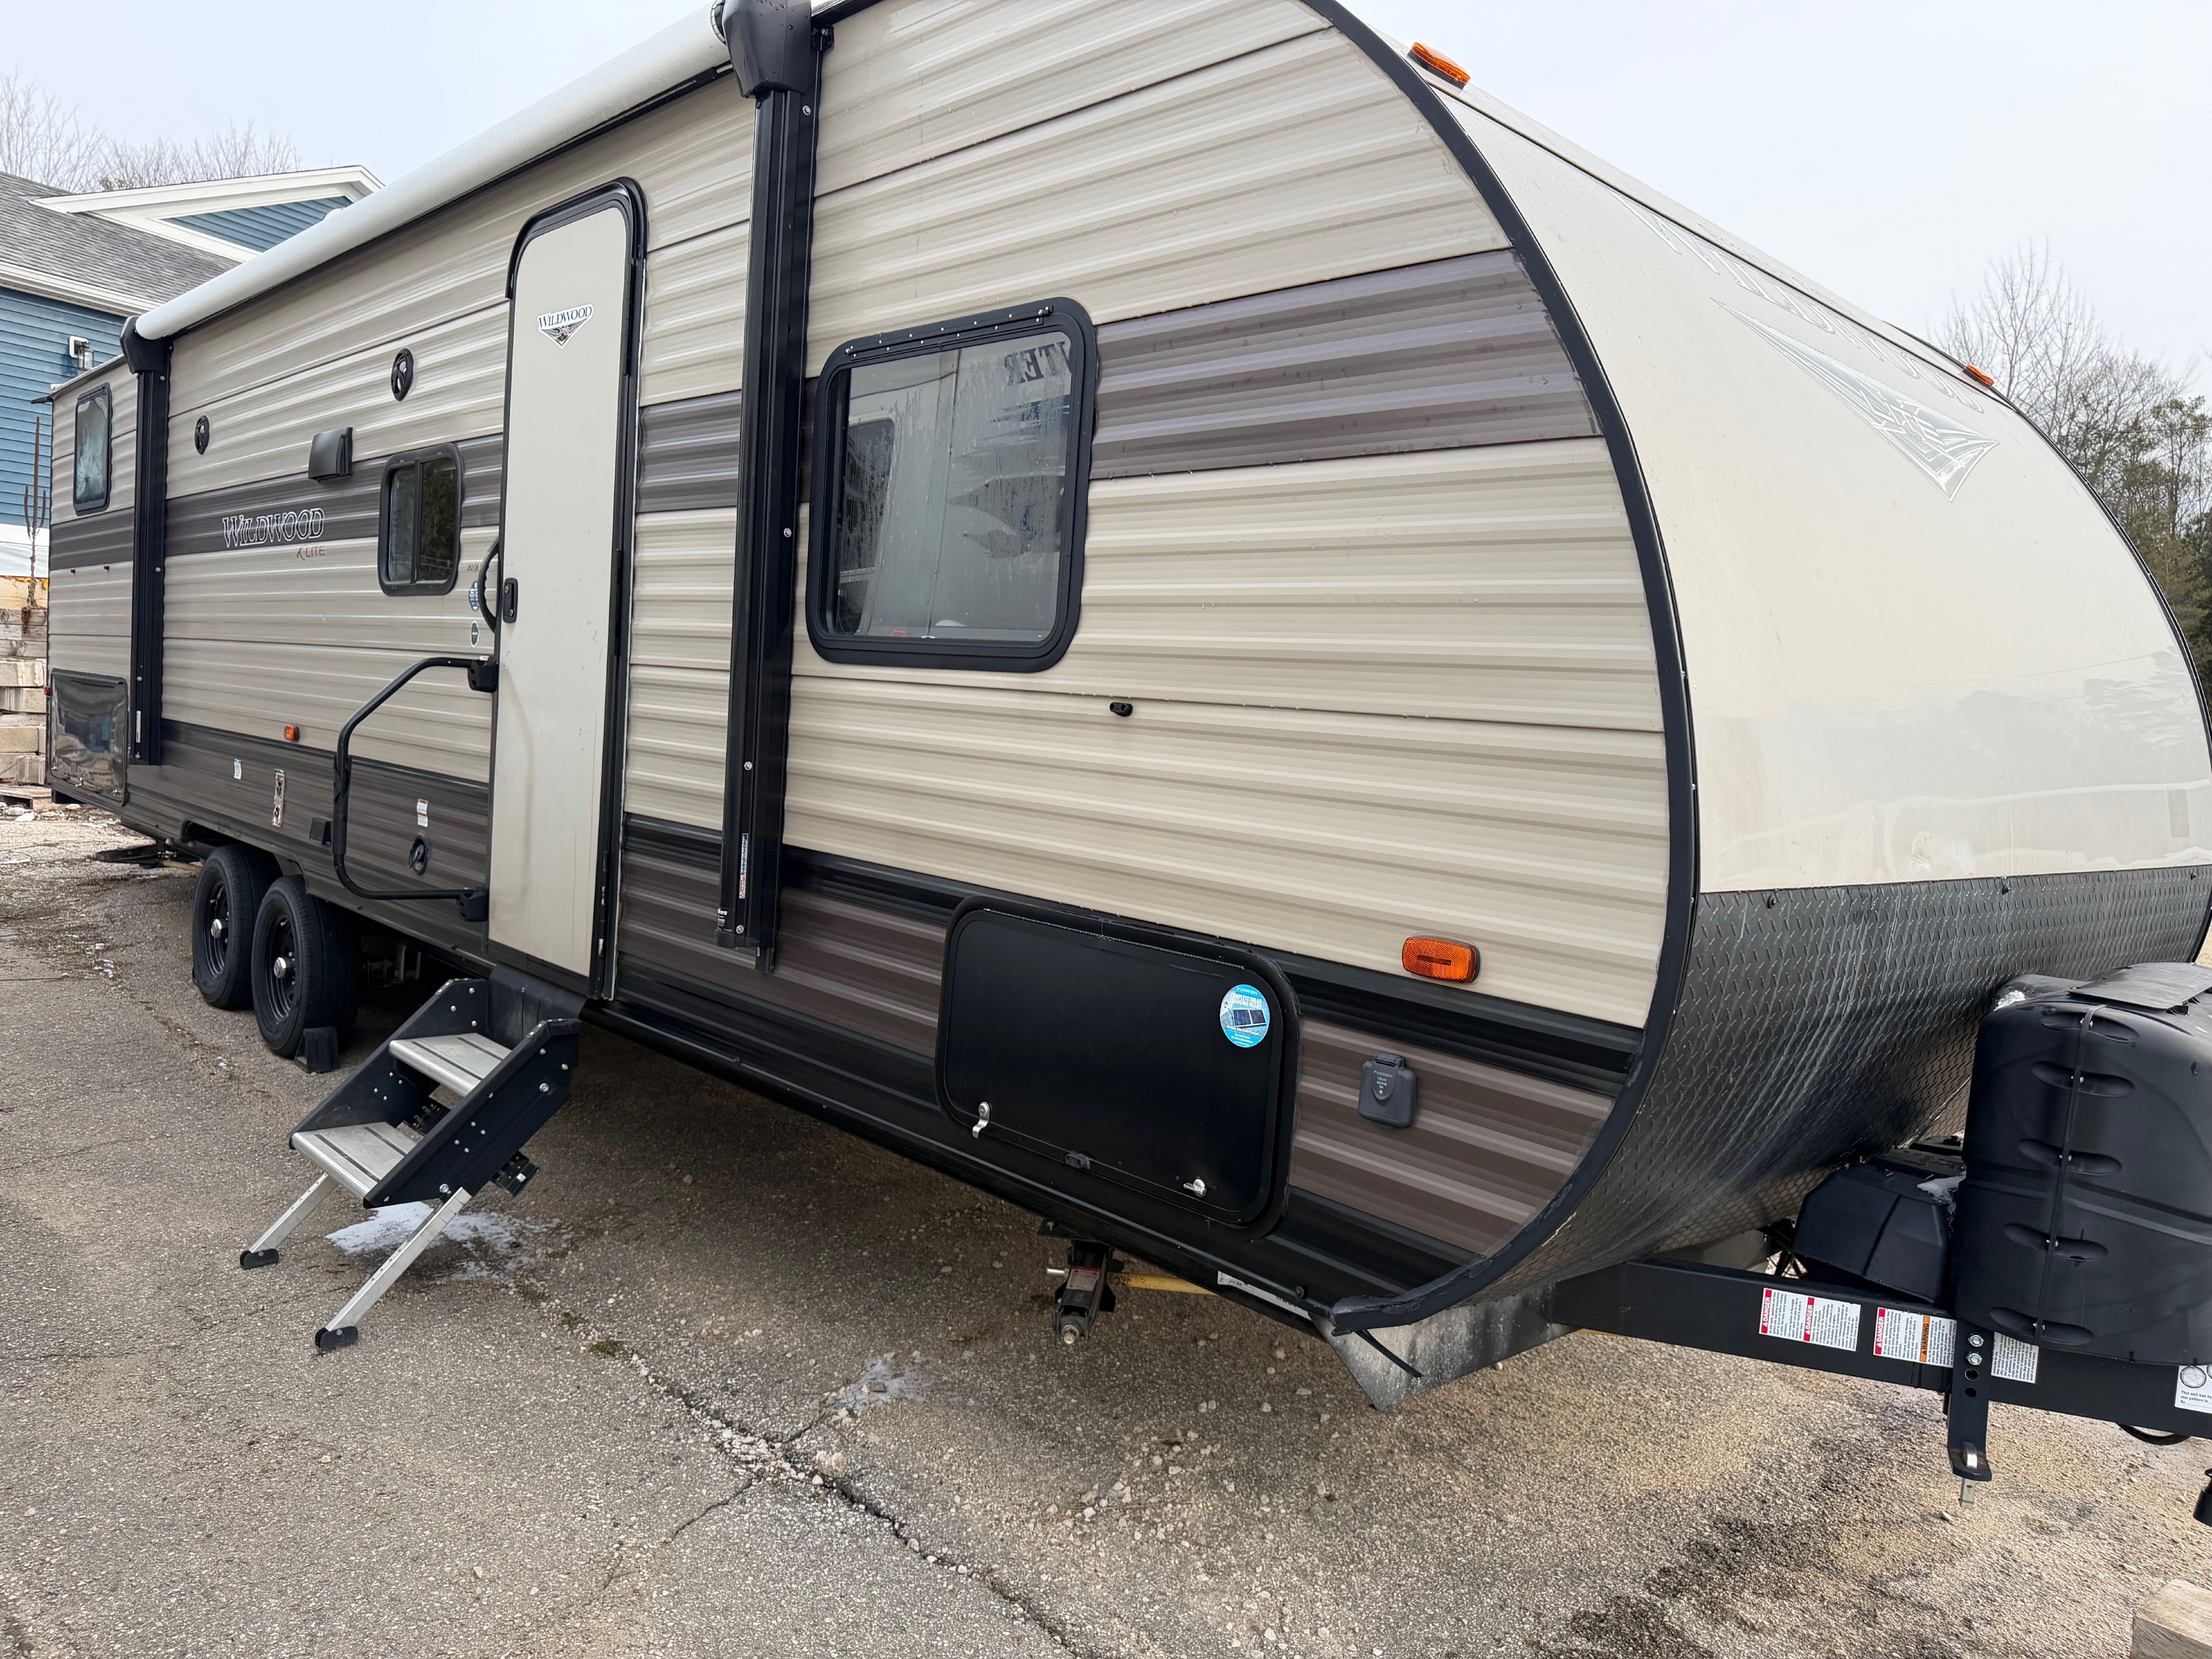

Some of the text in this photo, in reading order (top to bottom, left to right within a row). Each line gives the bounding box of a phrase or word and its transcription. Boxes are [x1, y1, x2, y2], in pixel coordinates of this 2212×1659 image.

[539, 306, 592, 327] WILDWOOD
[222, 508, 325, 548] WILDWOOD
[1230, 992, 1249, 1001] COMPLETE
